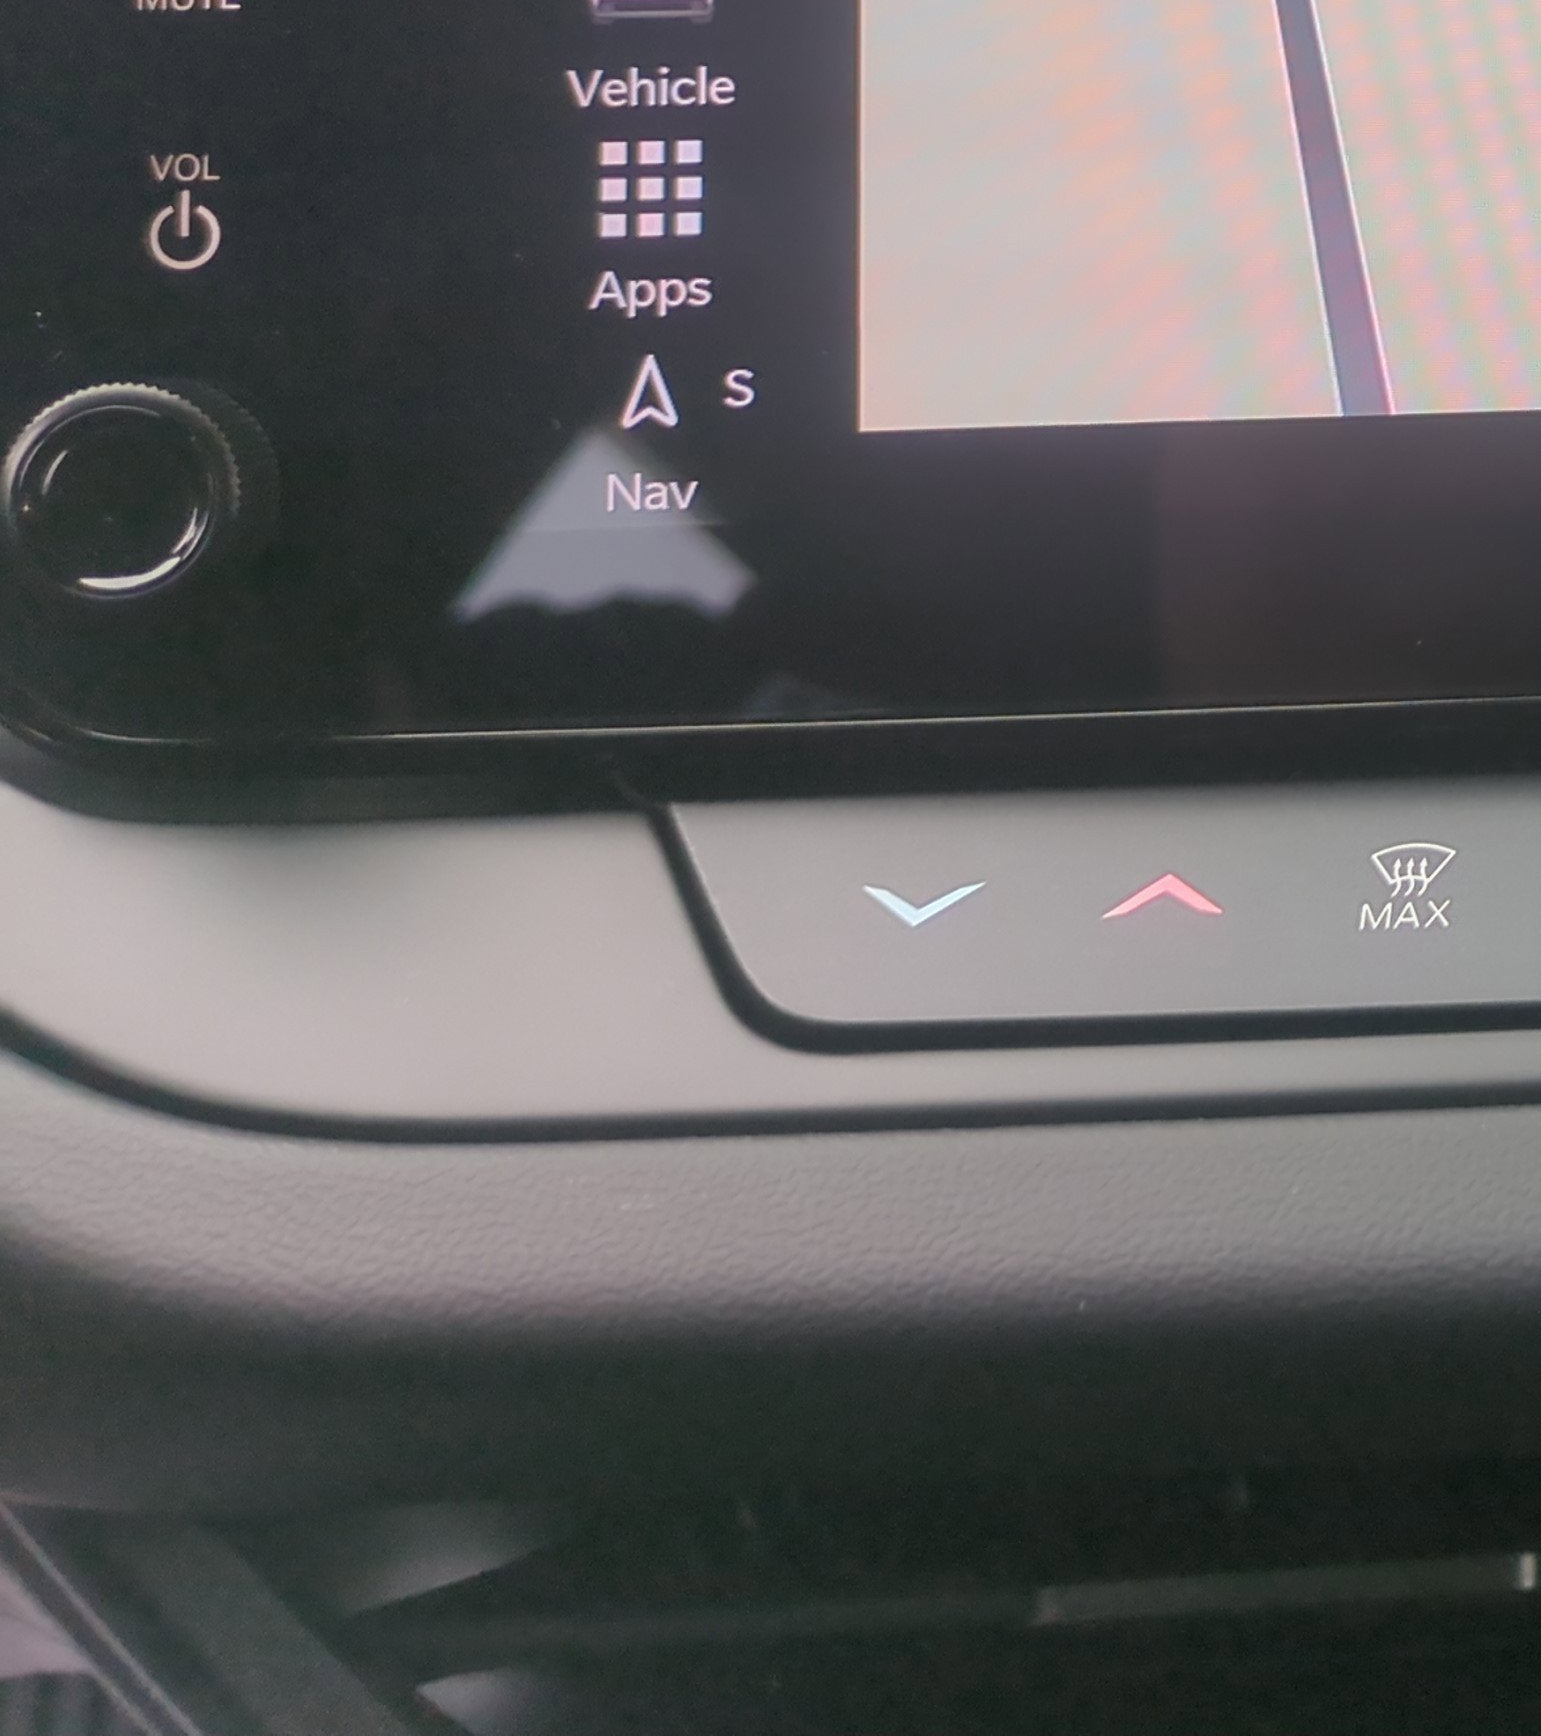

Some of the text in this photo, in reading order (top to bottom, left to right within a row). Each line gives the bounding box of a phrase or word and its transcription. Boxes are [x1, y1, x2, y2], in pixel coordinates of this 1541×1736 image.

[567, 67, 736, 107] Vehicle
[151, 154, 221, 182] VOL
[588, 271, 713, 317] Apps
[722, 370, 755, 408] S
[605, 474, 698, 512] Nav
[1358, 899, 1452, 930] MAX
